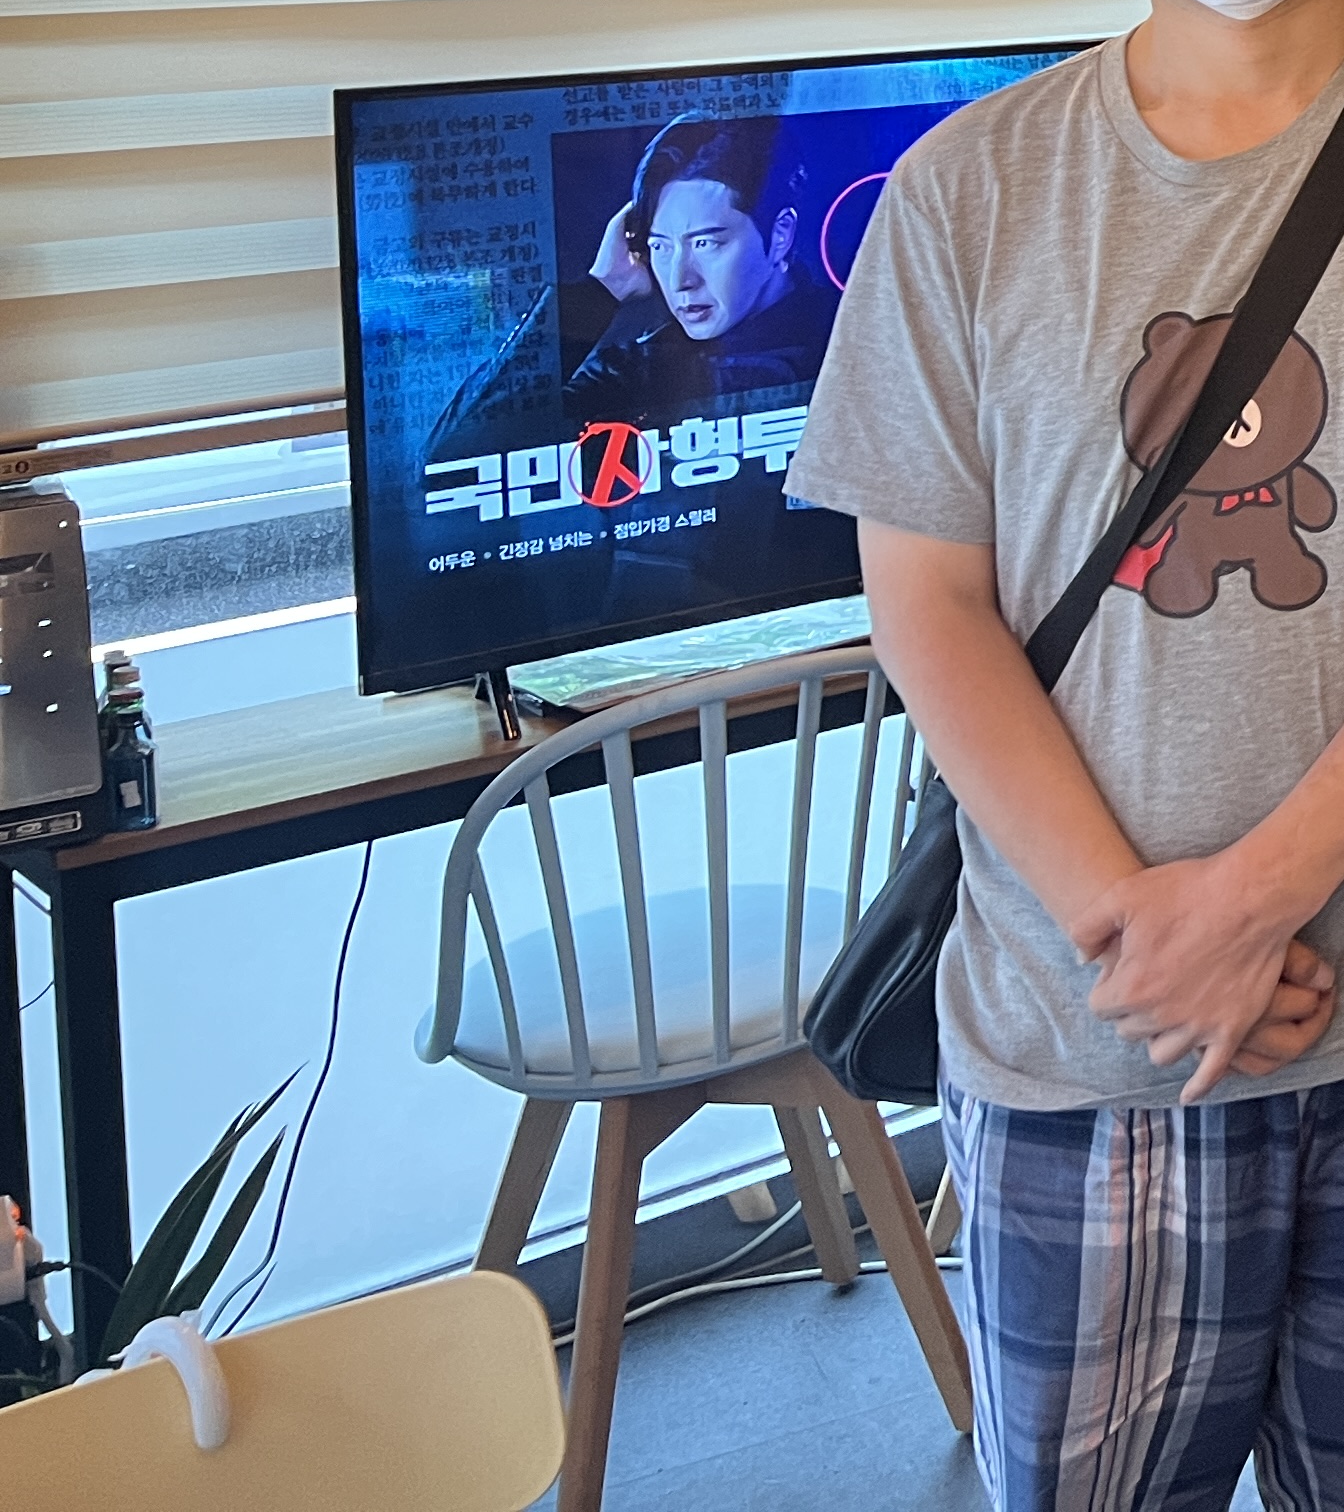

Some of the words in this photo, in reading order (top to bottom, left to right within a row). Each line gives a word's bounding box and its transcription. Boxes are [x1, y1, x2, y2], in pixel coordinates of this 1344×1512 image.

[428, 550, 476, 573] 어두운
[498, 538, 545, 560] 긴장감
[549, 531, 594, 552] 넘치는
[614, 515, 671, 540] 점입가경
[674, 507, 717, 527] 스릴러
